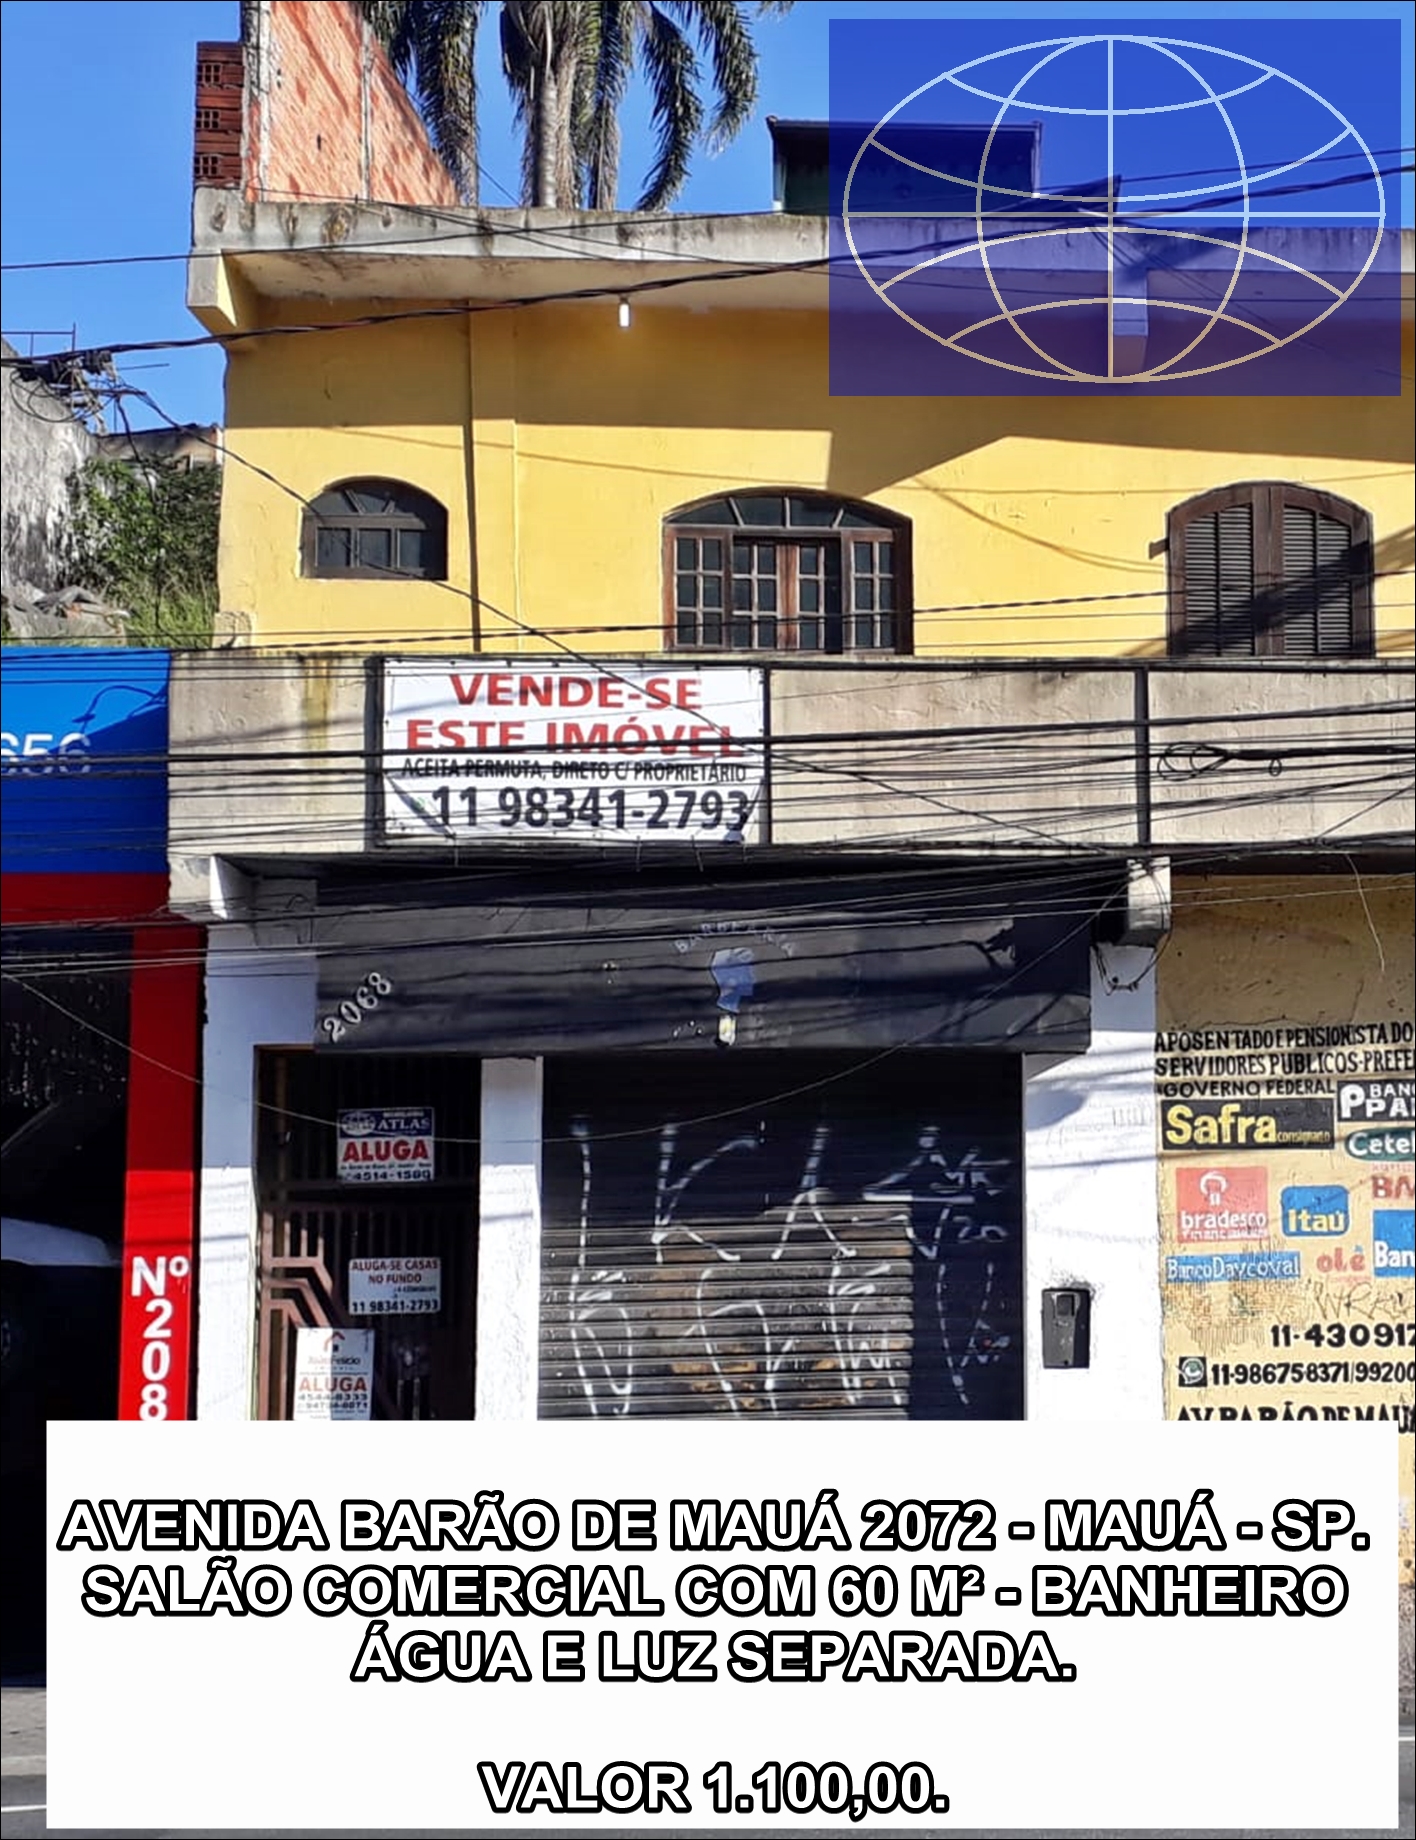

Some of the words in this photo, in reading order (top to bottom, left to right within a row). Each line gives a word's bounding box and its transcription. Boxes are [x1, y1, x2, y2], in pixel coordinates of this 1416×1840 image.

[449, 673, 702, 711] VENDE-SE
[406, 719, 526, 751] ESTE
[546, 716, 743, 757] IMÓVEL
[402, 757, 459, 777] ACEITA
[463, 759, 547, 781] PERMUTA,
[552, 759, 609, 779] DIRETO
[633, 757, 746, 782] PROPRIETÁRIO
[431, 785, 478, 828] 11
[499, 786, 748, 830] 98341-2793
[324, 972, 391, 1042] 2068
[1155, 1029, 1274, 1052] APOSENTADO
[1155, 1055, 1267, 1077] SERVIDORES
[1265, 1079, 1335, 1096] FEDERAL
[378, 1118, 431, 1131] ATLAS
[1166, 1104, 1277, 1144] Safra
[343, 1140, 429, 1162] ALUGA
[1181, 1210, 1267, 1229] bradesco
[131, 1256, 190, 1297] Nº
[352, 1261, 401, 1271] ALUGA-SE
[404, 1260, 438, 1270] CASAS
[369, 1274, 384, 1283] NO
[386, 1273, 422, 1284] FUNDO
[353, 1302, 365, 1312] 11
[369, 1300, 438, 1312] 98341-2793
[299, 1377, 367, 1392] ALUGA
